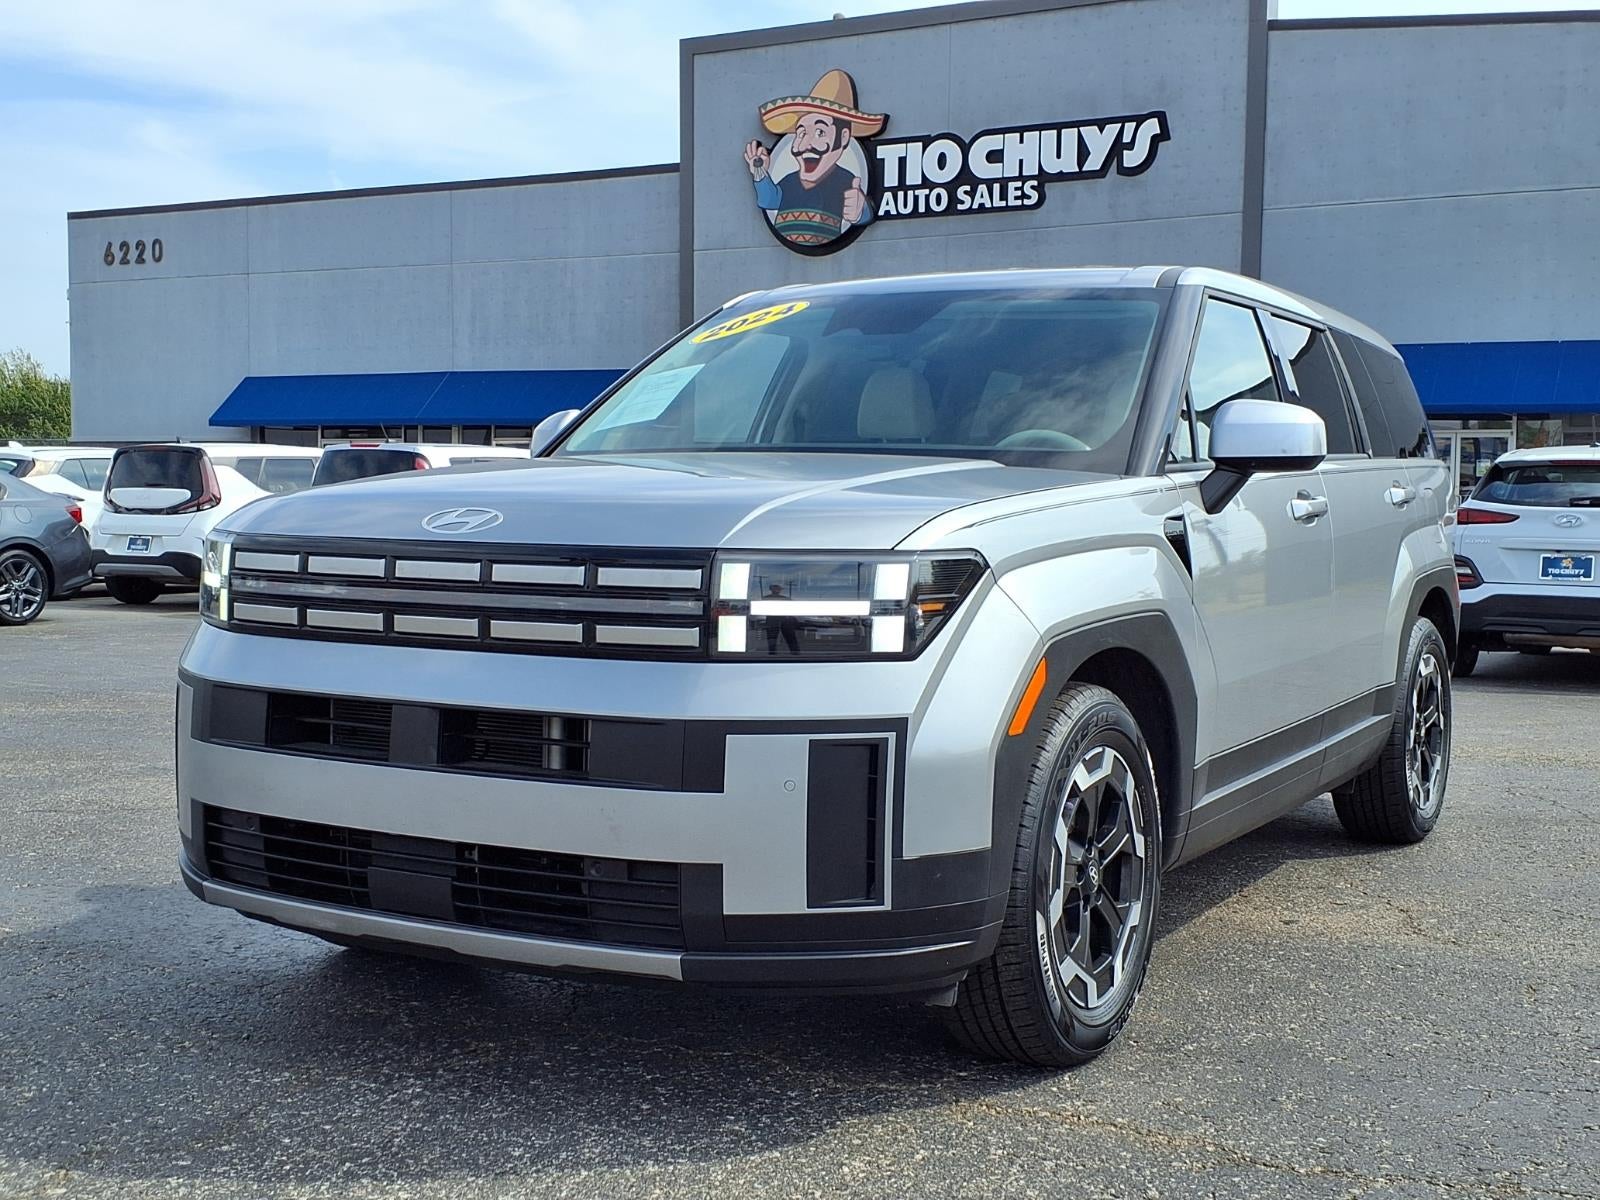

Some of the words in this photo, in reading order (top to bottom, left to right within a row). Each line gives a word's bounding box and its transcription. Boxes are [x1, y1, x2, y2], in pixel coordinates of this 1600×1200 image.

[876, 138, 963, 188] TIO
[968, 117, 1161, 180] CHUY'S
[878, 187, 949, 217] AUTO
[956, 179, 1040, 211] SALES
[103, 238, 164, 267] 6220
[700, 303, 799, 341] 2024
[1040, 932, 1052, 985] WEATHER
